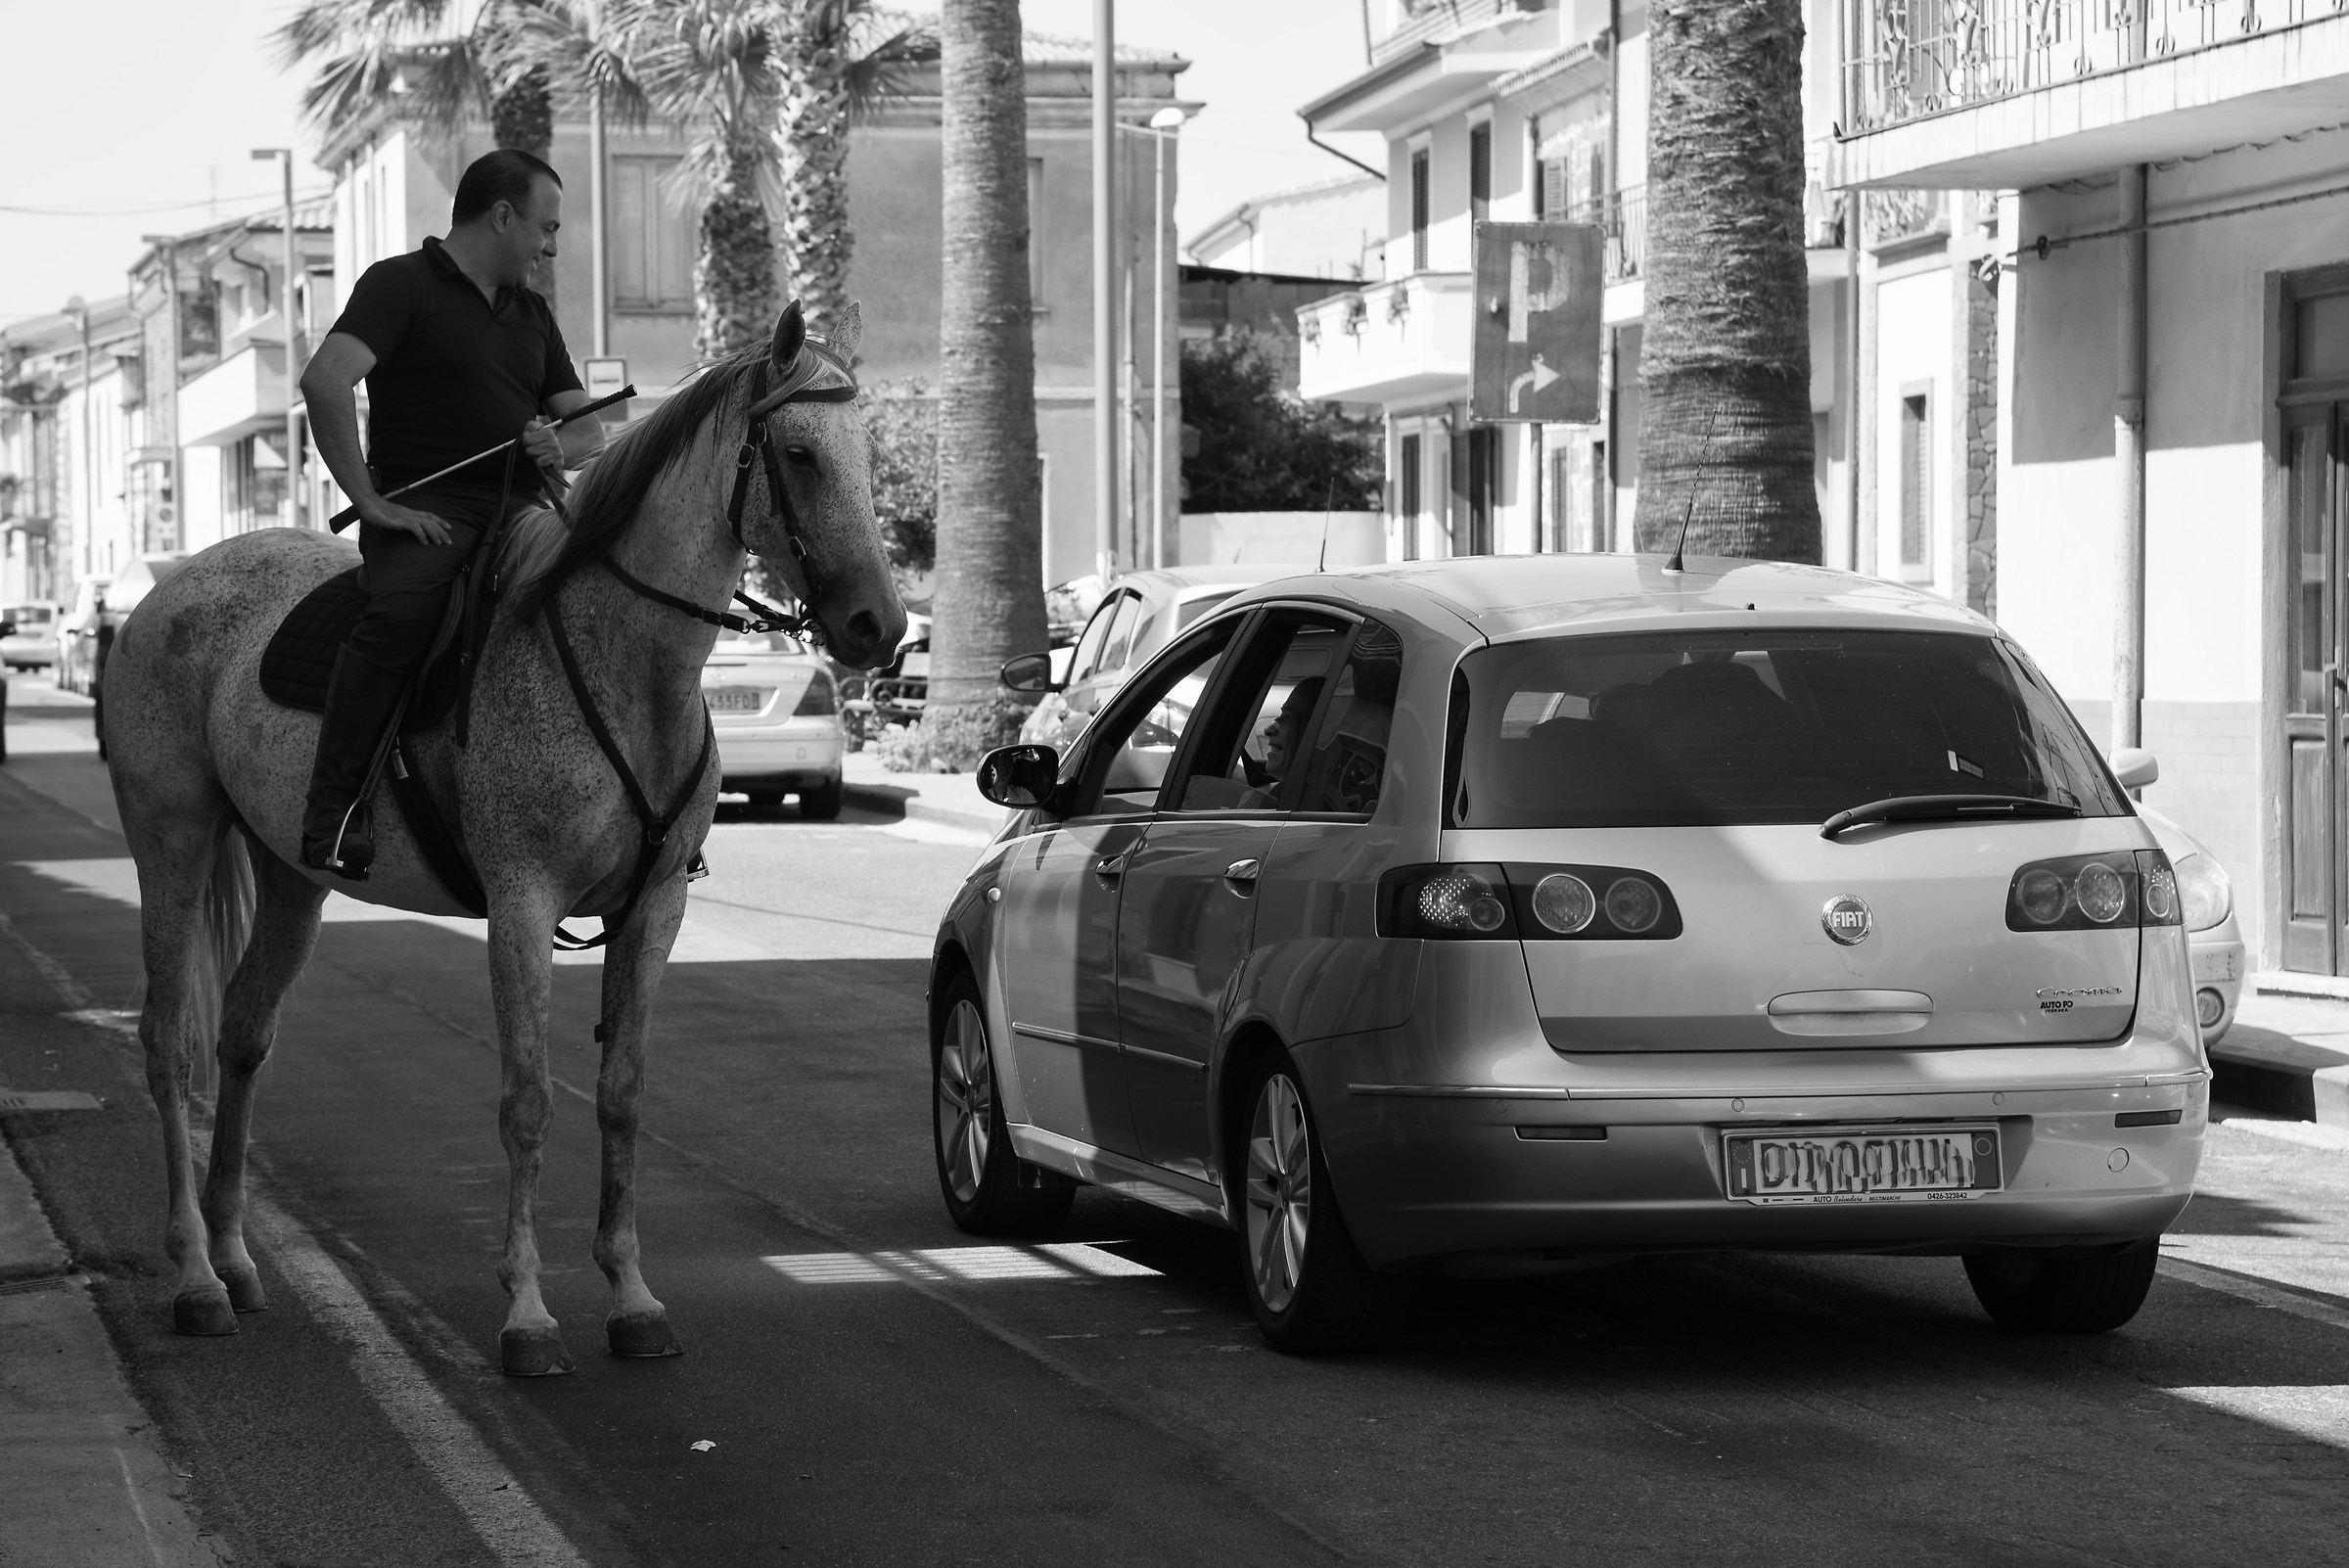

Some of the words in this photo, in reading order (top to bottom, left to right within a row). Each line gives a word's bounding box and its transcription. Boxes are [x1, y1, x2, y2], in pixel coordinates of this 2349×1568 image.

[1508, 241, 1571, 343] P
[1832, 911, 1864, 928] FIAT
[2040, 1000, 2062, 1009] AUTO
